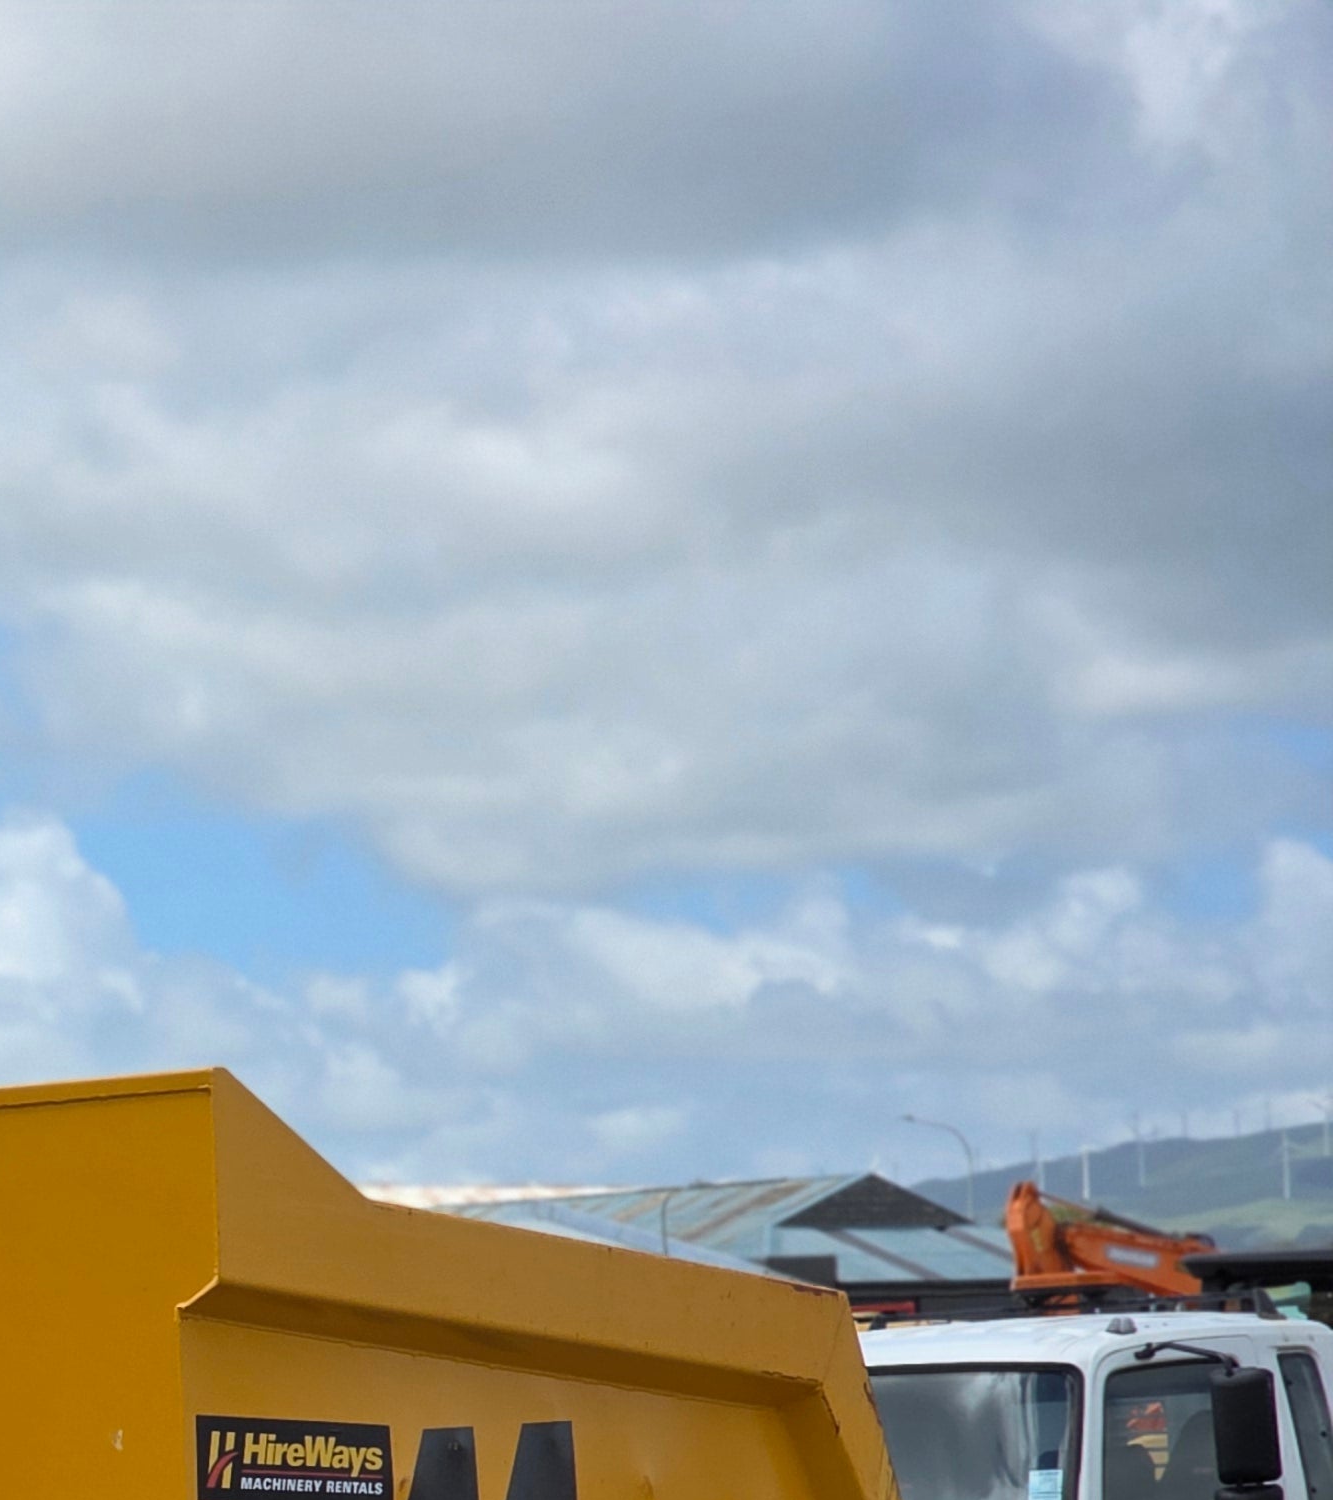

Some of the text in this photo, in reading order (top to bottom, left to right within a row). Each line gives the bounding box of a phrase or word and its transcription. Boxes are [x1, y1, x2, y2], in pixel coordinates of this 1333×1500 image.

[243, 1432, 383, 1477] HireWays
[240, 1477, 383, 1495] MACHINERY RENTALS
